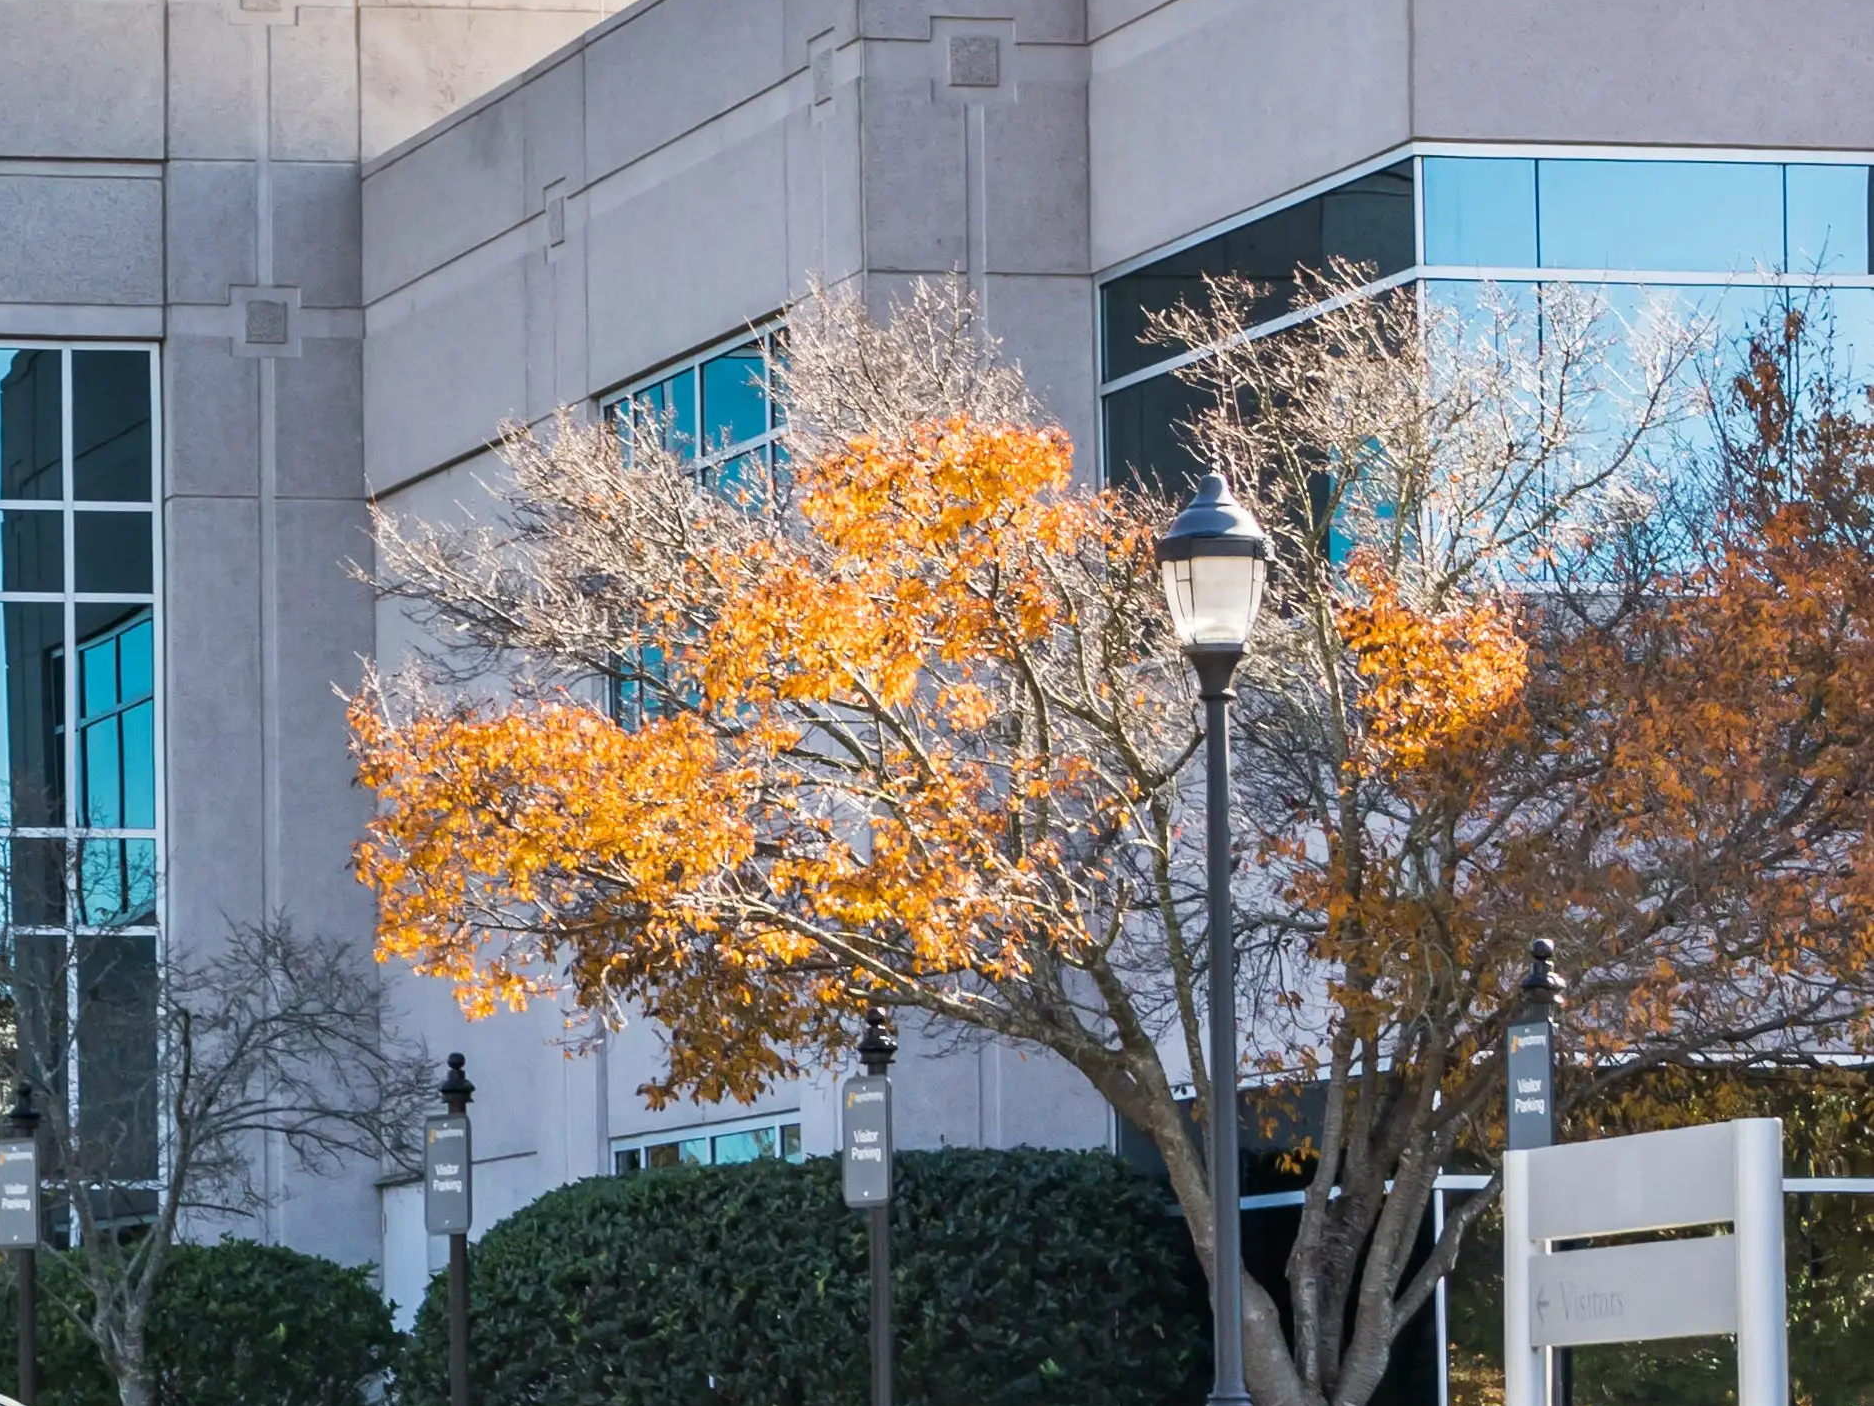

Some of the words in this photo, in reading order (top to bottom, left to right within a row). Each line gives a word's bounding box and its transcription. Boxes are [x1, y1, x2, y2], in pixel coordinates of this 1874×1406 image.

[1517, 1078, 1542, 1093] Visitor
[1515, 1098, 1545, 1115] Parking
[854, 1129, 879, 1143] Visitor
[851, 1146, 881, 1162] Parking
[433, 1179, 462, 1193] Parking
[1558, 1279, 1624, 1322] Visitors
